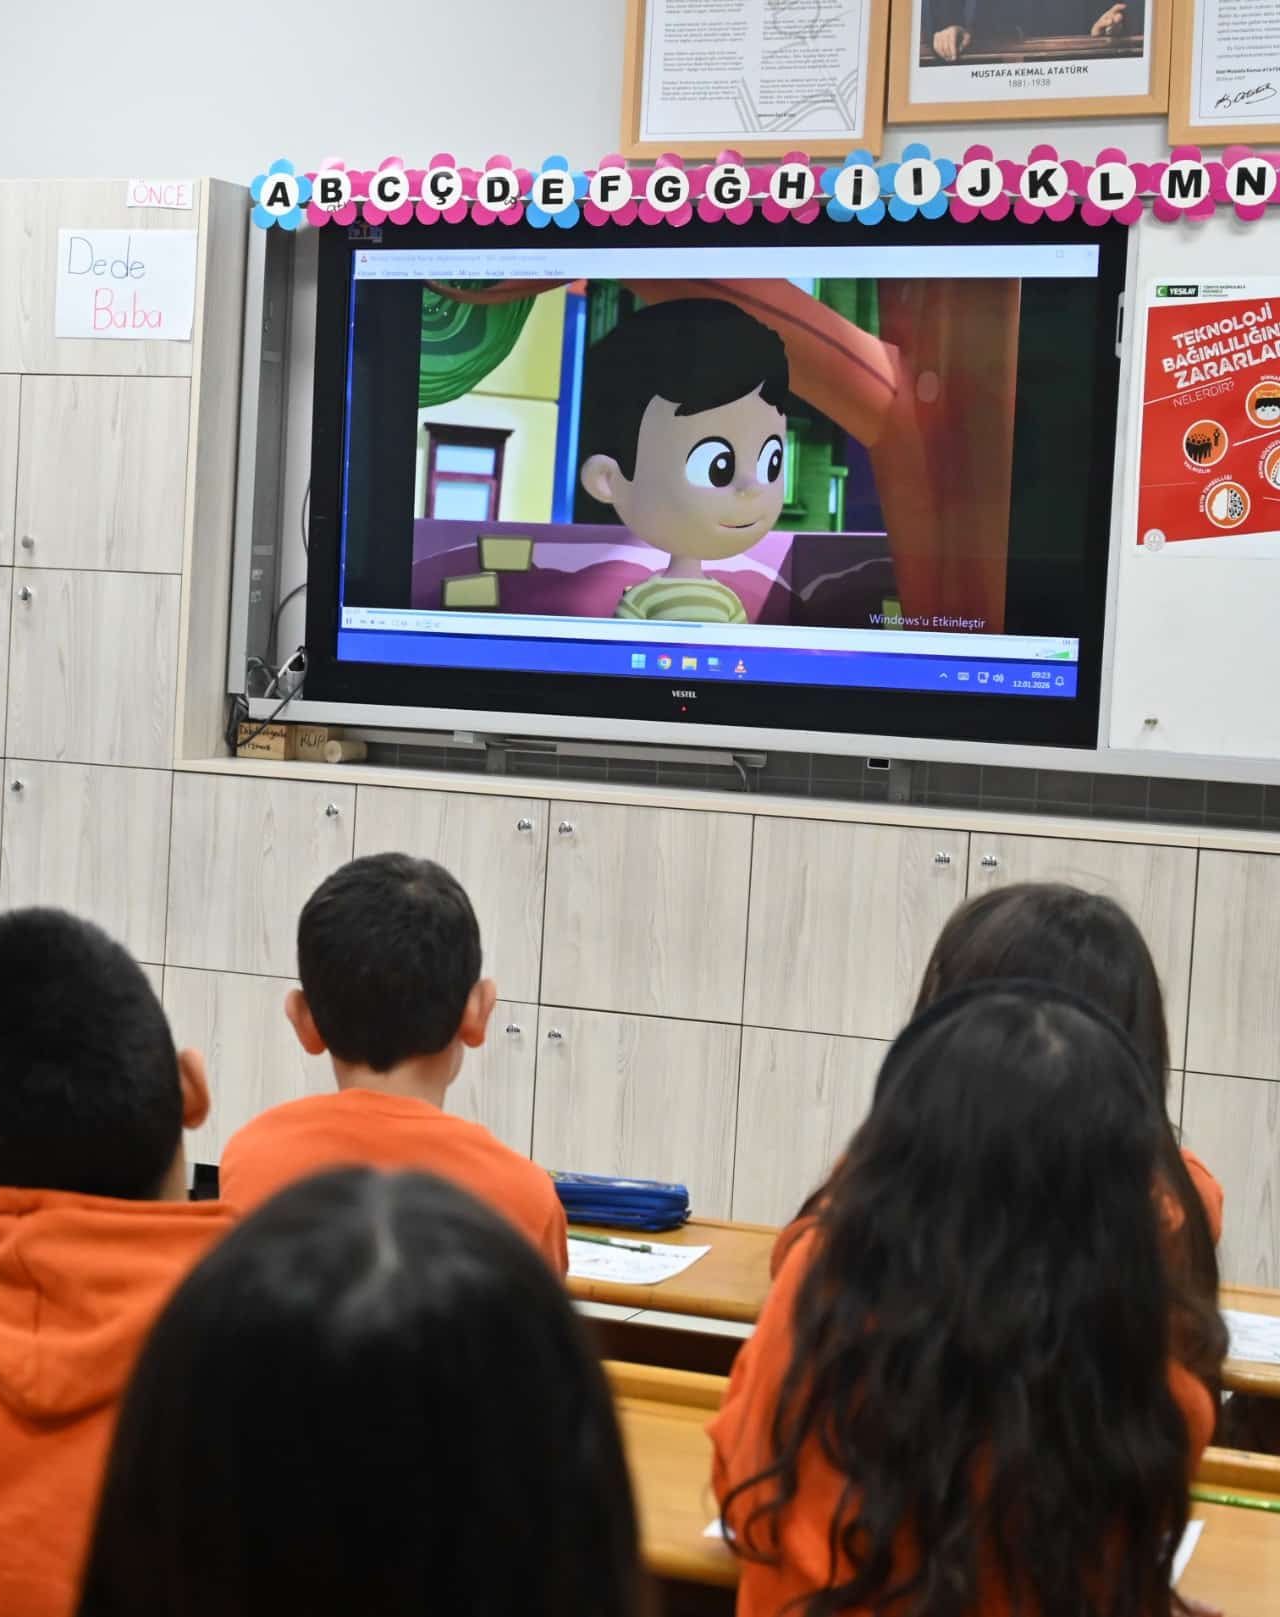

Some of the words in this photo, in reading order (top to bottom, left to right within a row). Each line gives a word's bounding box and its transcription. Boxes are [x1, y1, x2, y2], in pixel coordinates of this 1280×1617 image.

[971, 68, 1013, 79] MUSTAFA
[1015, 67, 1045, 77] KEMAL
[1047, 64, 1089, 75] ATATÜRK
[266, 181, 291, 207] A
[320, 178, 343, 203] B
[377, 176, 401, 202] C
[430, 171, 454, 205] Ç
[486, 176, 511, 202] D
[541, 178, 564, 205] E
[600, 175, 621, 202] F
[654, 175, 681, 203] G
[714, 168, 741, 204] Ğ
[778, 172, 806, 200] H
[967, 167, 990, 197] J
[1027, 167, 1059, 199] K
[1099, 171, 1124, 201] L
[1167, 169, 1203, 199] M
[1235, 166, 1266, 196] N
[67, 235, 146, 280] Dede
[93, 287, 164, 331] Baba
[1172, 301, 1273, 349] TEKNOLOJİ
[1162, 321, 1280, 373] BAĞIMLILIĞIN
[869, 613, 929, 626] Windows'u
[932, 615, 985, 630] Etkinleştir
[671, 689, 697, 699] VESTEL
